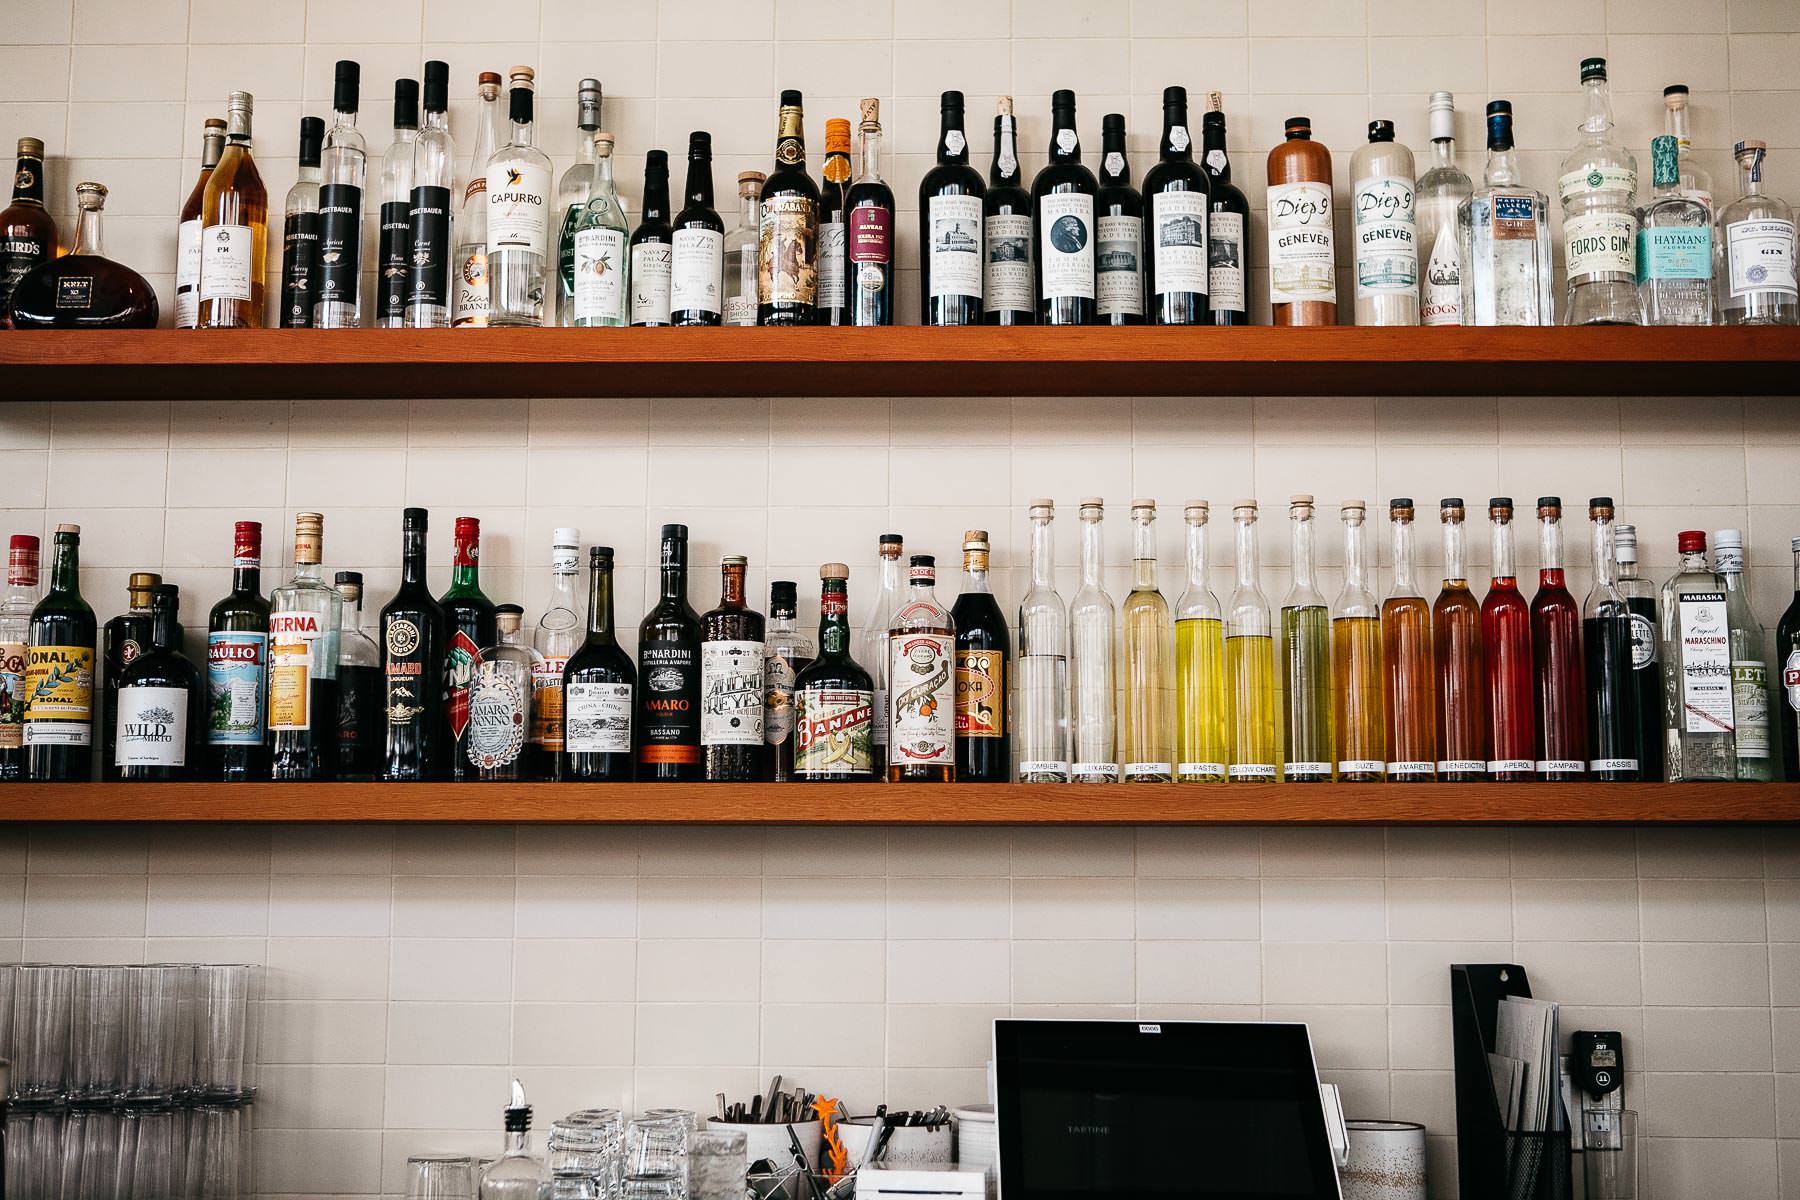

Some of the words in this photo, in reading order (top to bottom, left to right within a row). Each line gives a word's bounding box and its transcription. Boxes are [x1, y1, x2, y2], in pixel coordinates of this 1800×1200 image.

[491, 192, 542, 206] CAPURRO
[1496, 203, 1532, 211] MILLER'S
[1278, 232, 1330, 248] GENEVER
[1362, 228, 1412, 244] GENEVER
[0, 241, 41, 256] AIRD'S
[1571, 236, 1606, 258] FORDS
[1611, 235, 1629, 253] GIN
[268, 616, 319, 633] VERNA
[1690, 625, 1719, 636] Original
[1684, 636, 1727, 645] MARASCHINO
[26, 649, 70, 667] ONAL
[652, 649, 691, 659] NARDINI
[385, 662, 422, 675] AMARO
[706, 673, 763, 699] ANCHO
[645, 699, 689, 711] AMARO
[705, 688, 763, 716] REYES
[474, 704, 509, 716] AMARO
[473, 715, 510, 727] NONINO
[124, 723, 167, 737] WILD
[650, 728, 681, 736] BASSANO
[797, 707, 873, 749] BANANE
[1193, 764, 1218, 772] PASTIS
[1398, 763, 1434, 771] AMARETTO
[1547, 762, 1579, 770] CAMPARI
